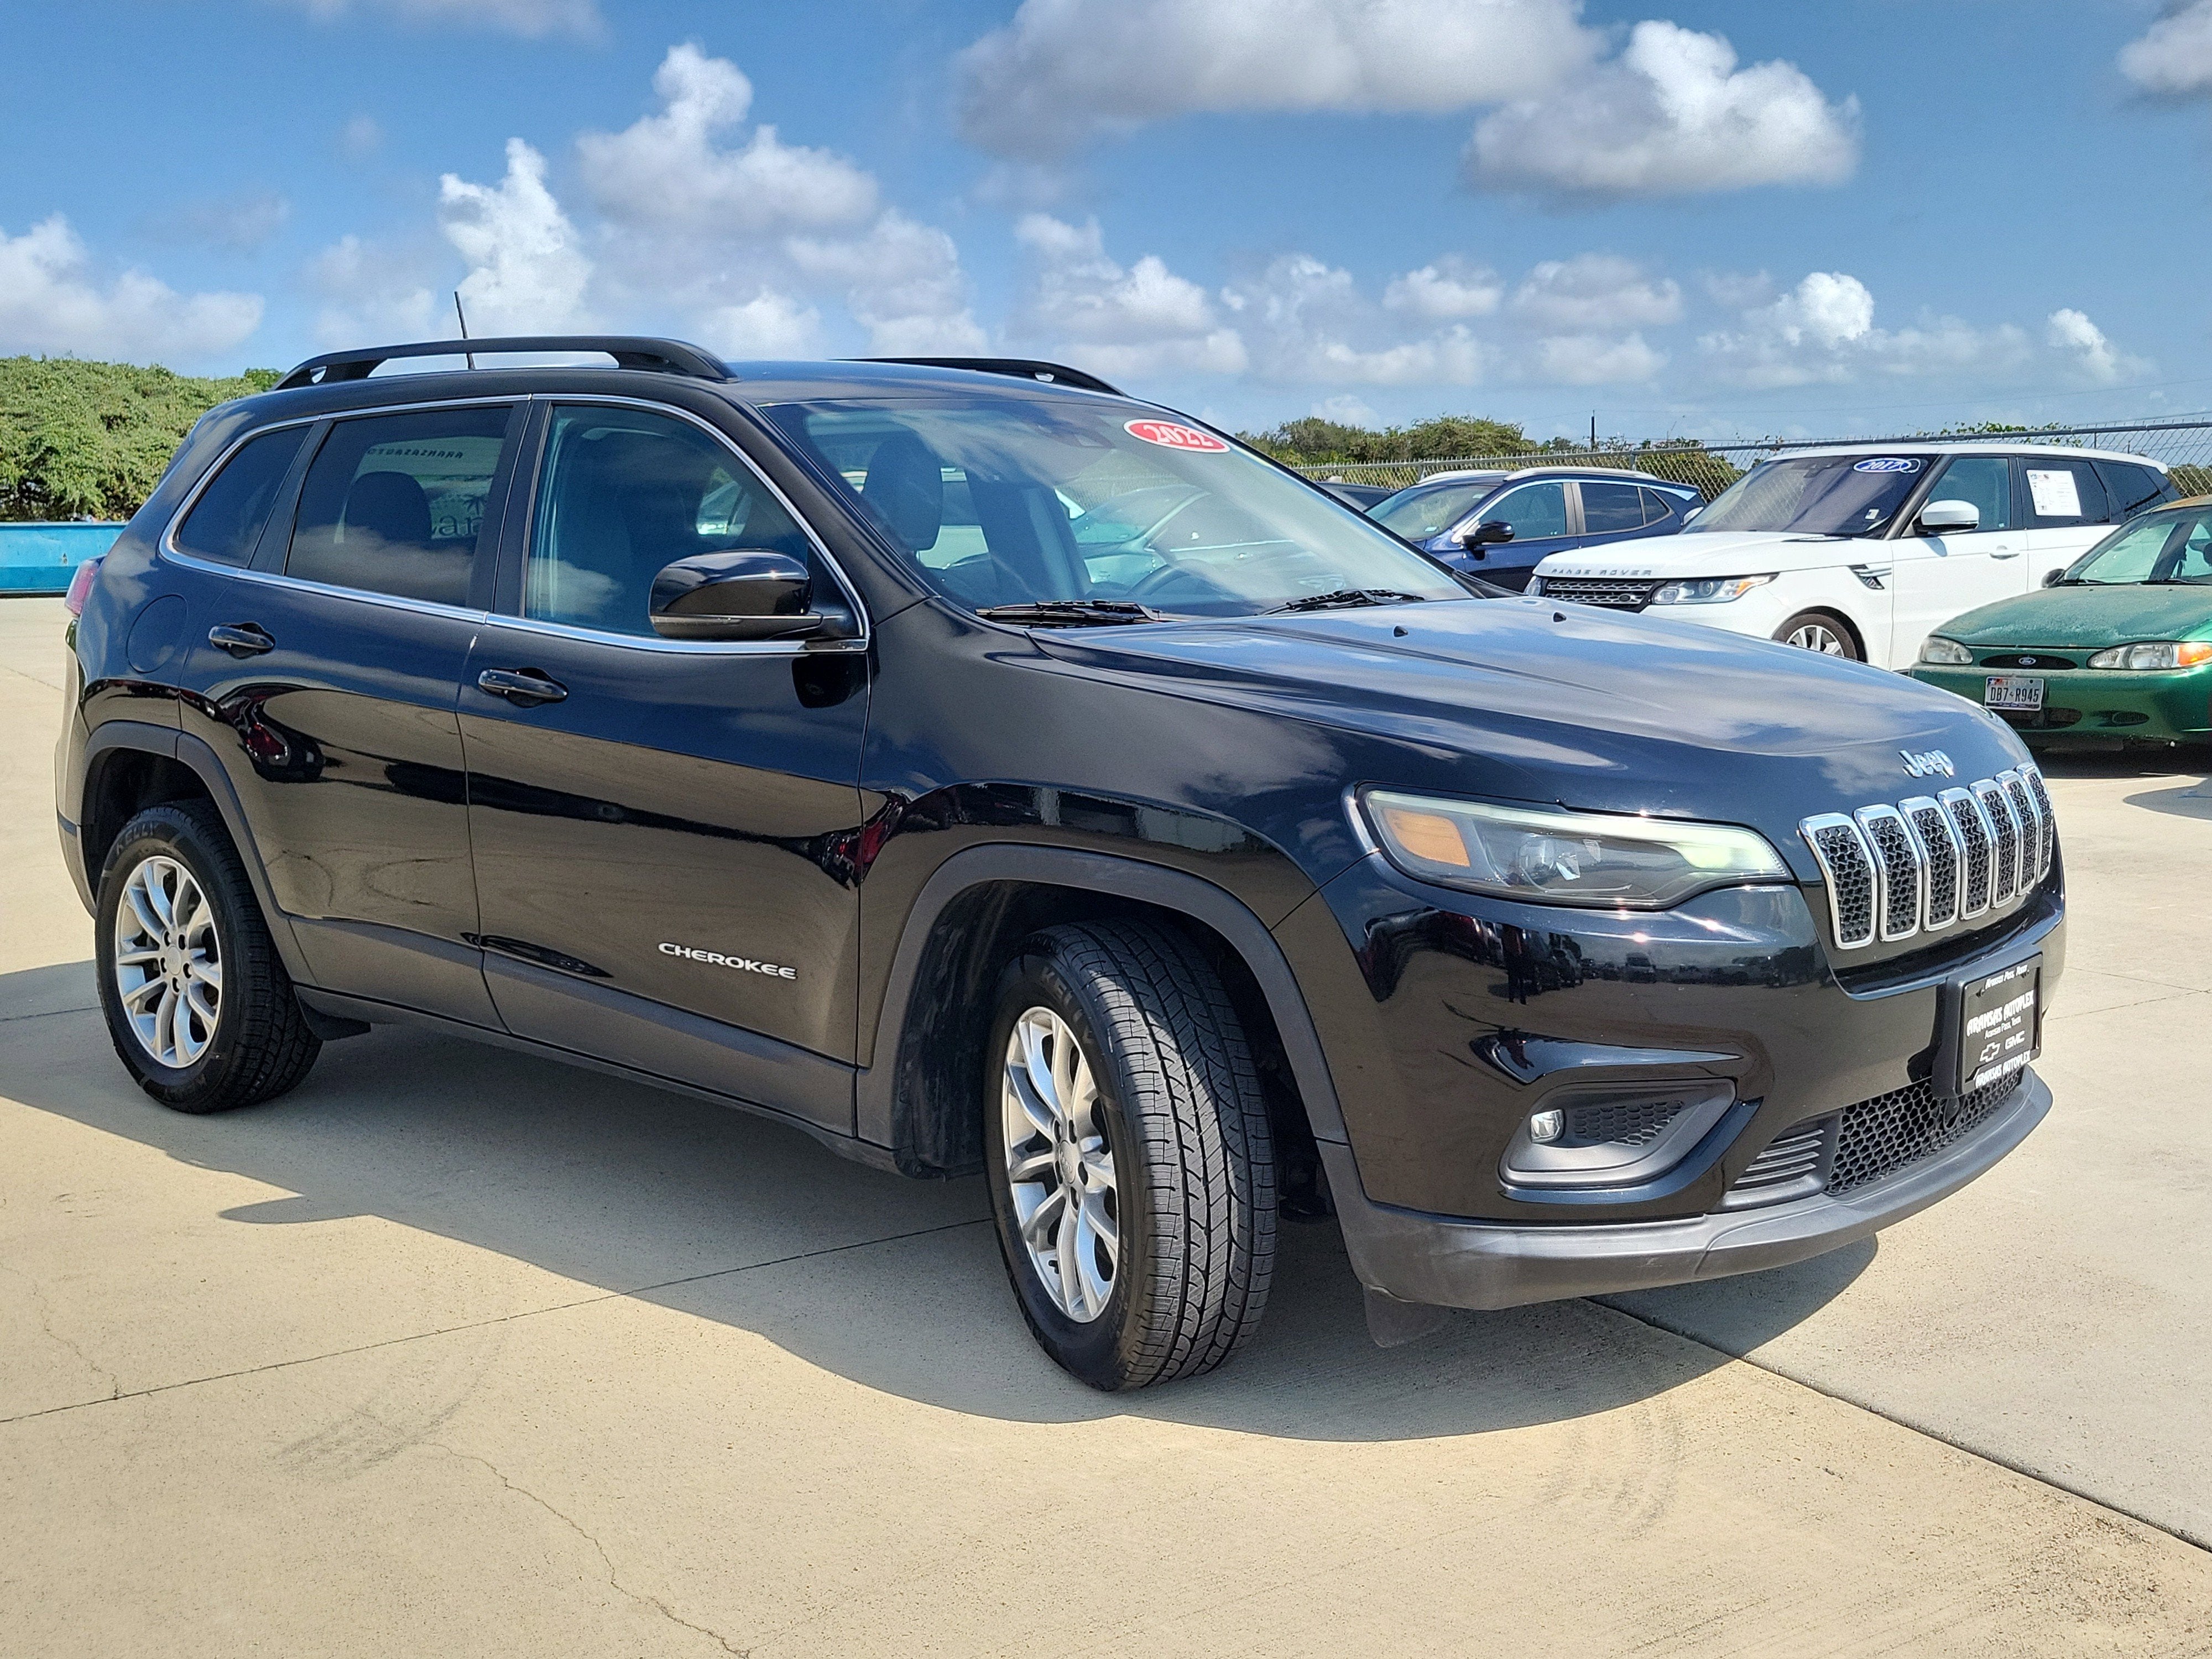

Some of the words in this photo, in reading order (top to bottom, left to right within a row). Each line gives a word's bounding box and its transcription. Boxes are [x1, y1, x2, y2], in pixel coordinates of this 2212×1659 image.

[1142, 424, 1214, 447] 2022
[1861, 461, 1901, 470] 2017
[1990, 686, 2008, 701] DB7
[2015, 687, 2039, 702] R945
[1898, 749, 1955, 779] Jeep
[658, 942, 797, 980] CHEROKEE
[1966, 1006, 2003, 1037] ARANSAS
[2003, 989, 2034, 1021] AUTOPLEX
[2005, 1030, 2025, 1050] GMC
